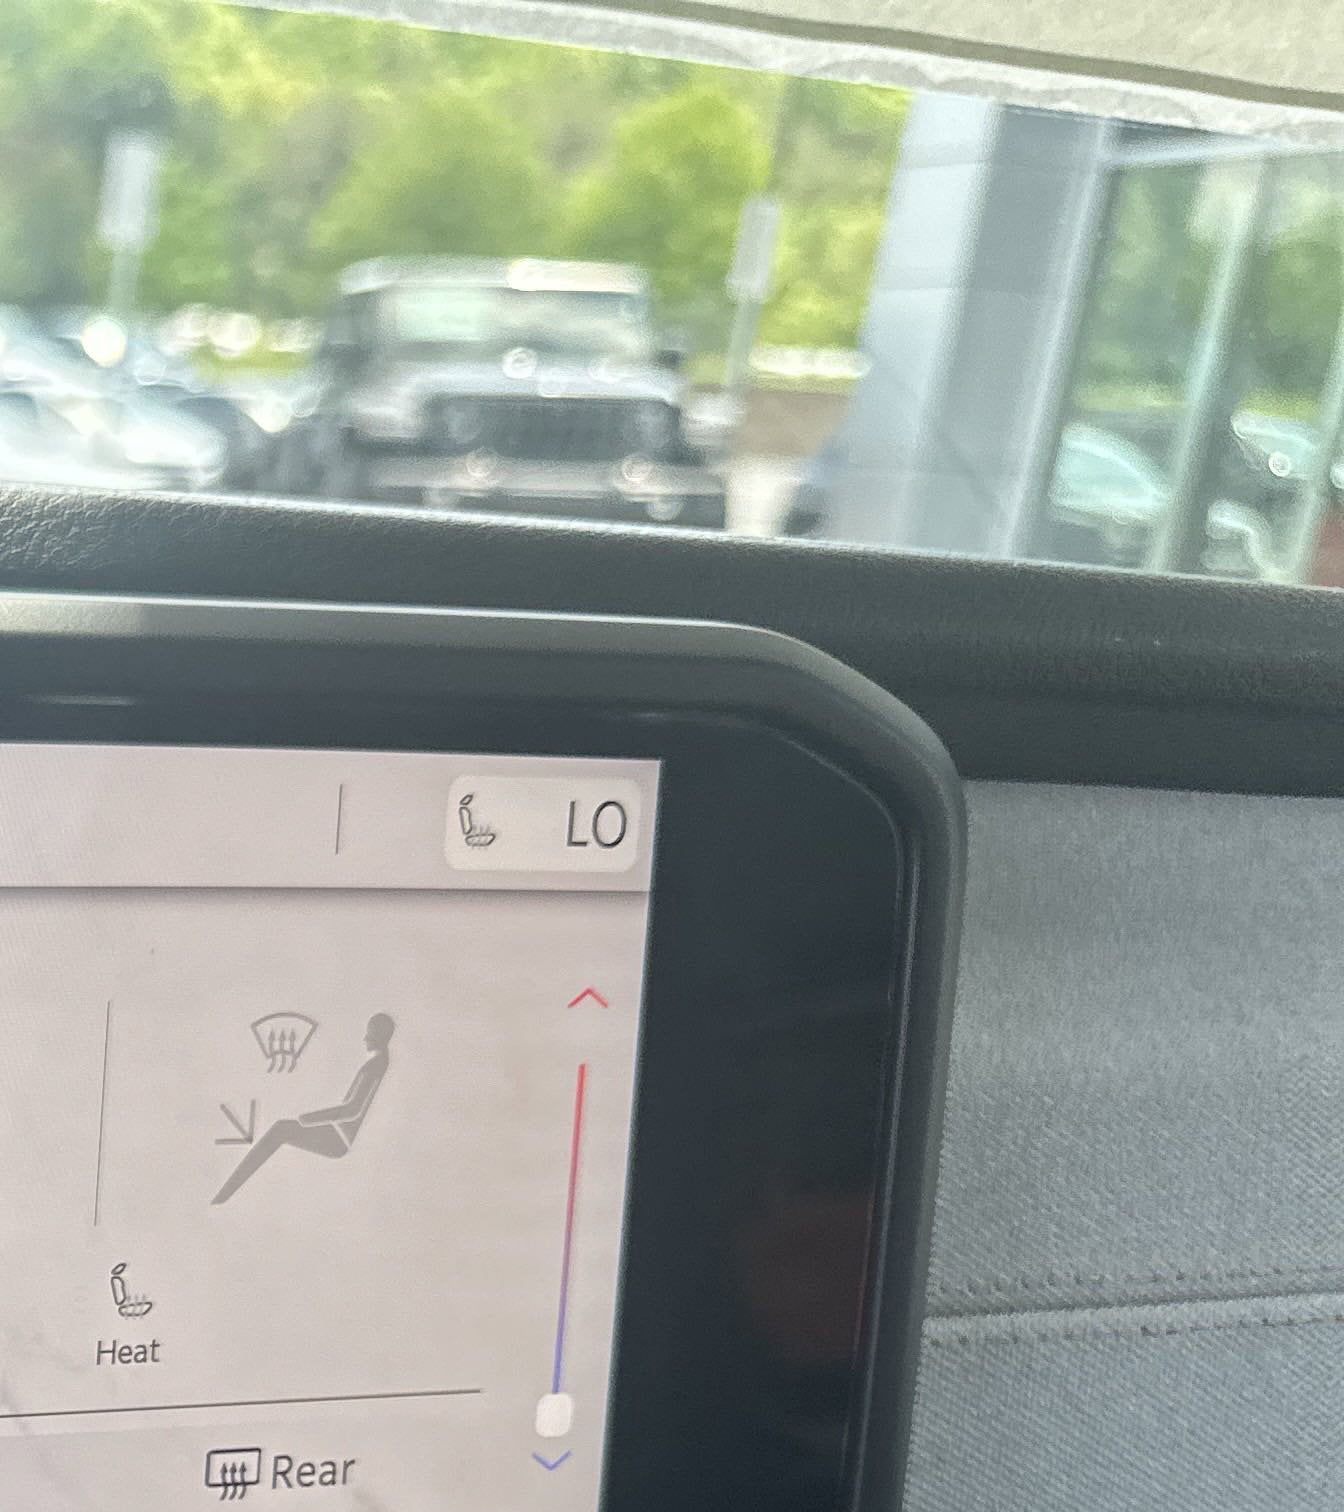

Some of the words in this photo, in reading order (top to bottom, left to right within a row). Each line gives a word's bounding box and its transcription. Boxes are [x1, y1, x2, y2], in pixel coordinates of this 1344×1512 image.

[565, 800, 628, 849] LO
[96, 1338, 161, 1368] Heat
[270, 1453, 357, 1491] Rear
